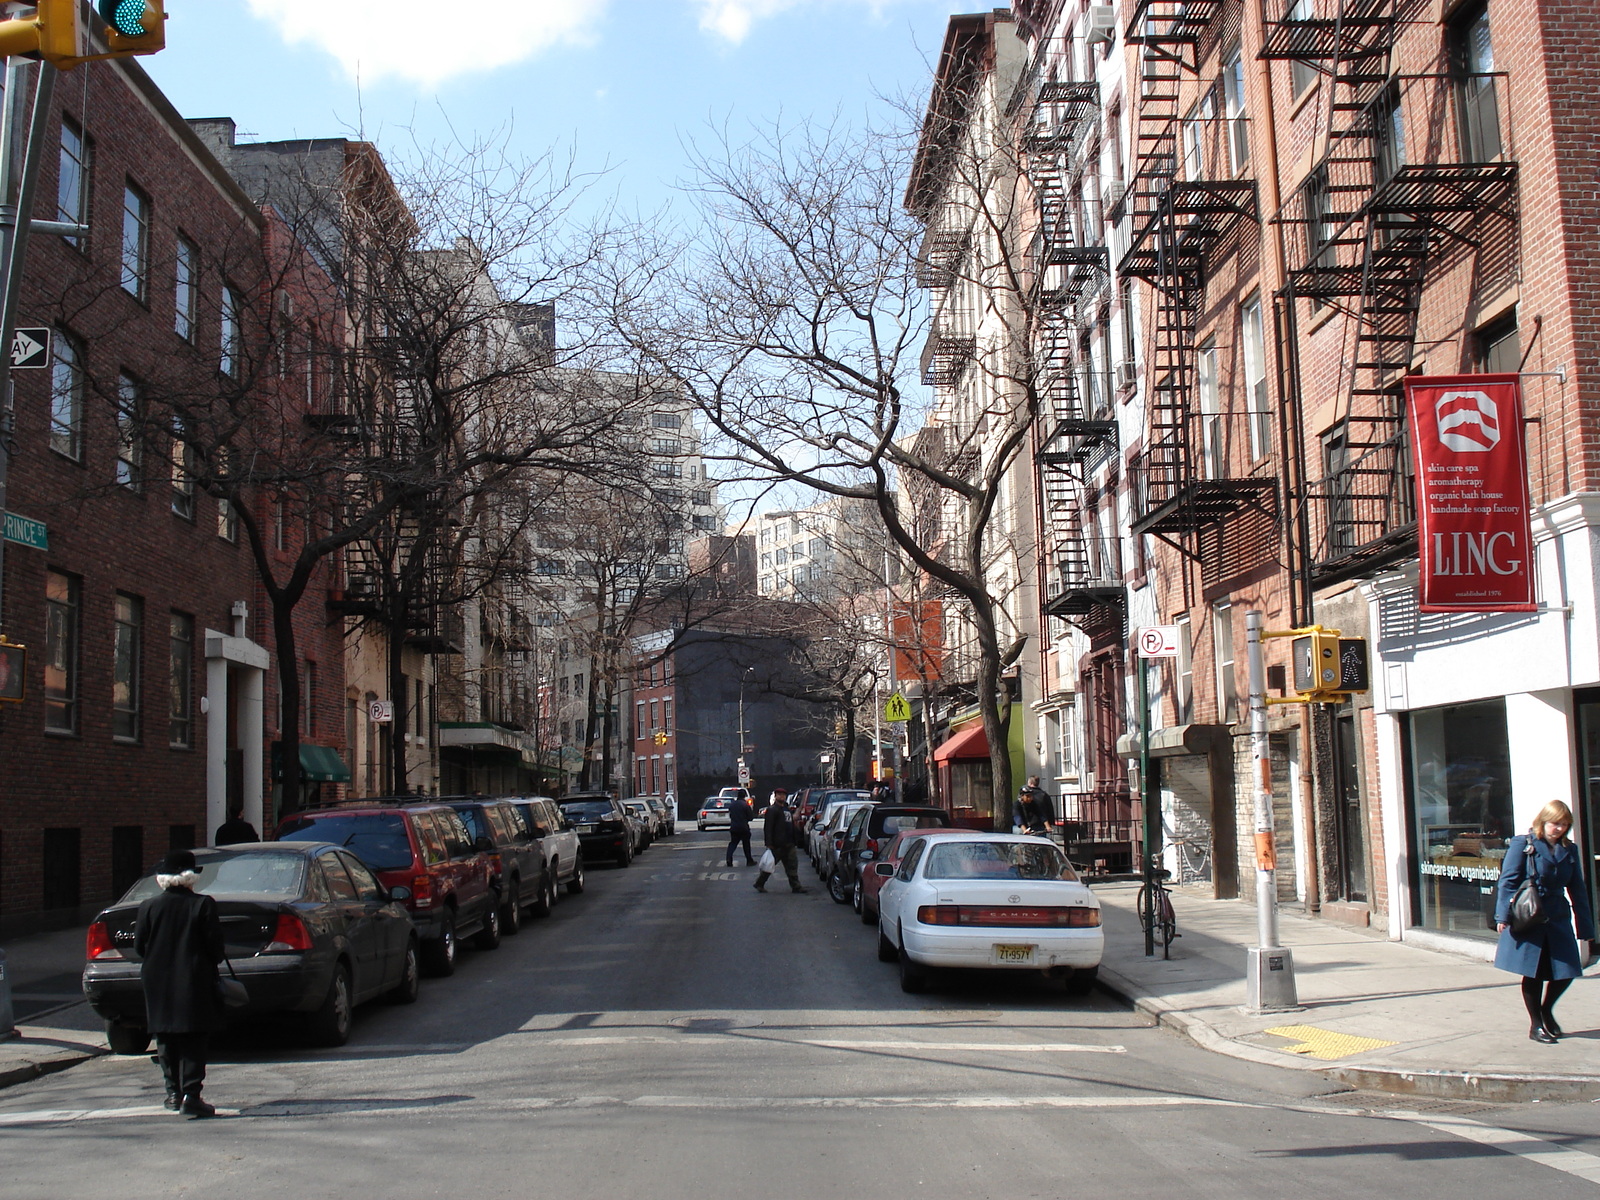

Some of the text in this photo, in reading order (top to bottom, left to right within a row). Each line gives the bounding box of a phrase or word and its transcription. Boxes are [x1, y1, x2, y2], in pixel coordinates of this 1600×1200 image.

[11, 341, 31, 355] AY
[1428, 463, 1445, 472] skin
[1465, 465, 1479, 474] spa
[1429, 476, 1484, 487] aromatherapy
[1430, 490, 1503, 502] organic bath house
[1430, 503, 1520, 515] handmade soap factory
[38, 525, 45, 537] ST
[1432, 531, 1521, 576] LING
[1447, 865, 1459, 880] spa
